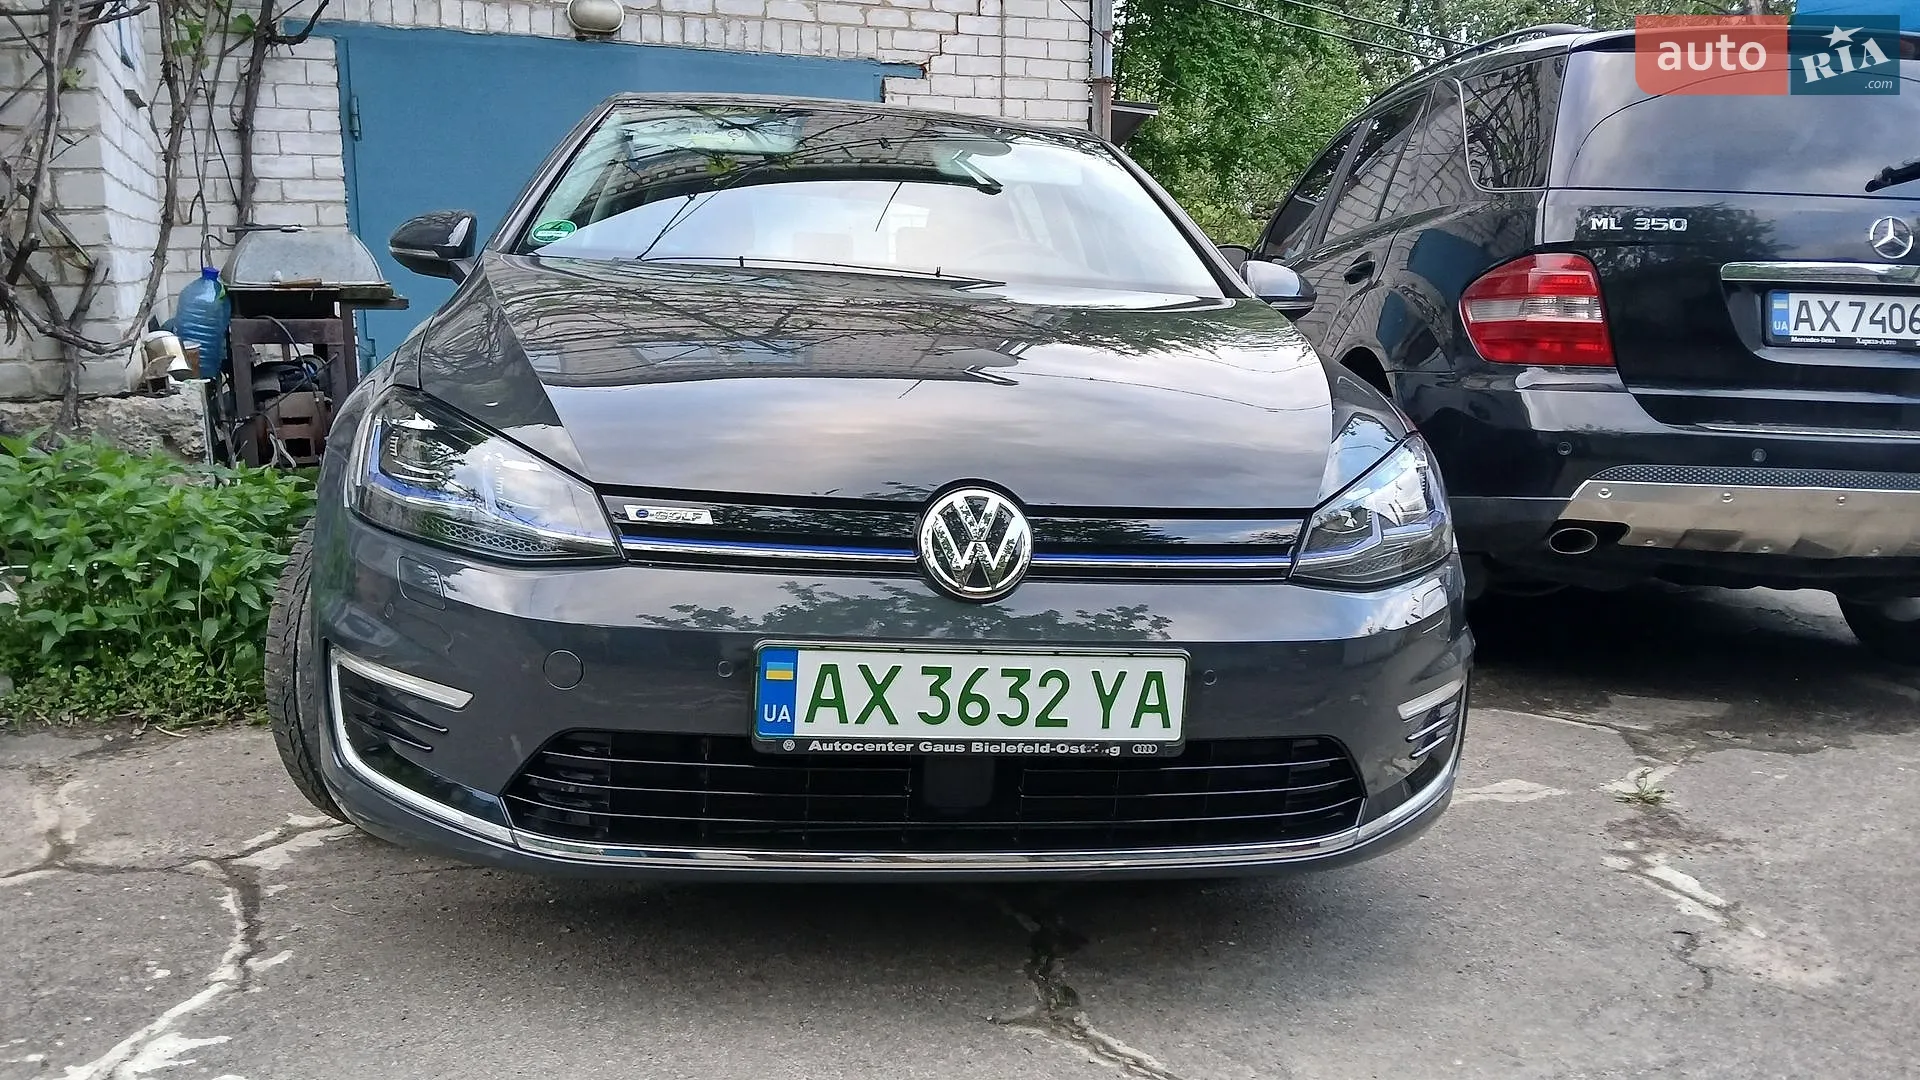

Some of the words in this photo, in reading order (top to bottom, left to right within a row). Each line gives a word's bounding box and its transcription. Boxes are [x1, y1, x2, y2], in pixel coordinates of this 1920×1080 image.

[1590, 217, 1623, 231] ML
[1633, 217, 1688, 232] 350
[1773, 320, 1788, 332] UA
[1793, 300, 1841, 333] AX
[1849, 301, 1920, 335] 7406
[804, 663, 903, 726] AX
[916, 665, 1071, 728] 3632
[1090, 670, 1171, 729] YA
[763, 704, 792, 724] UA
[808, 739, 914, 752] Autocenter
[918, 741, 966, 753] Gaus
